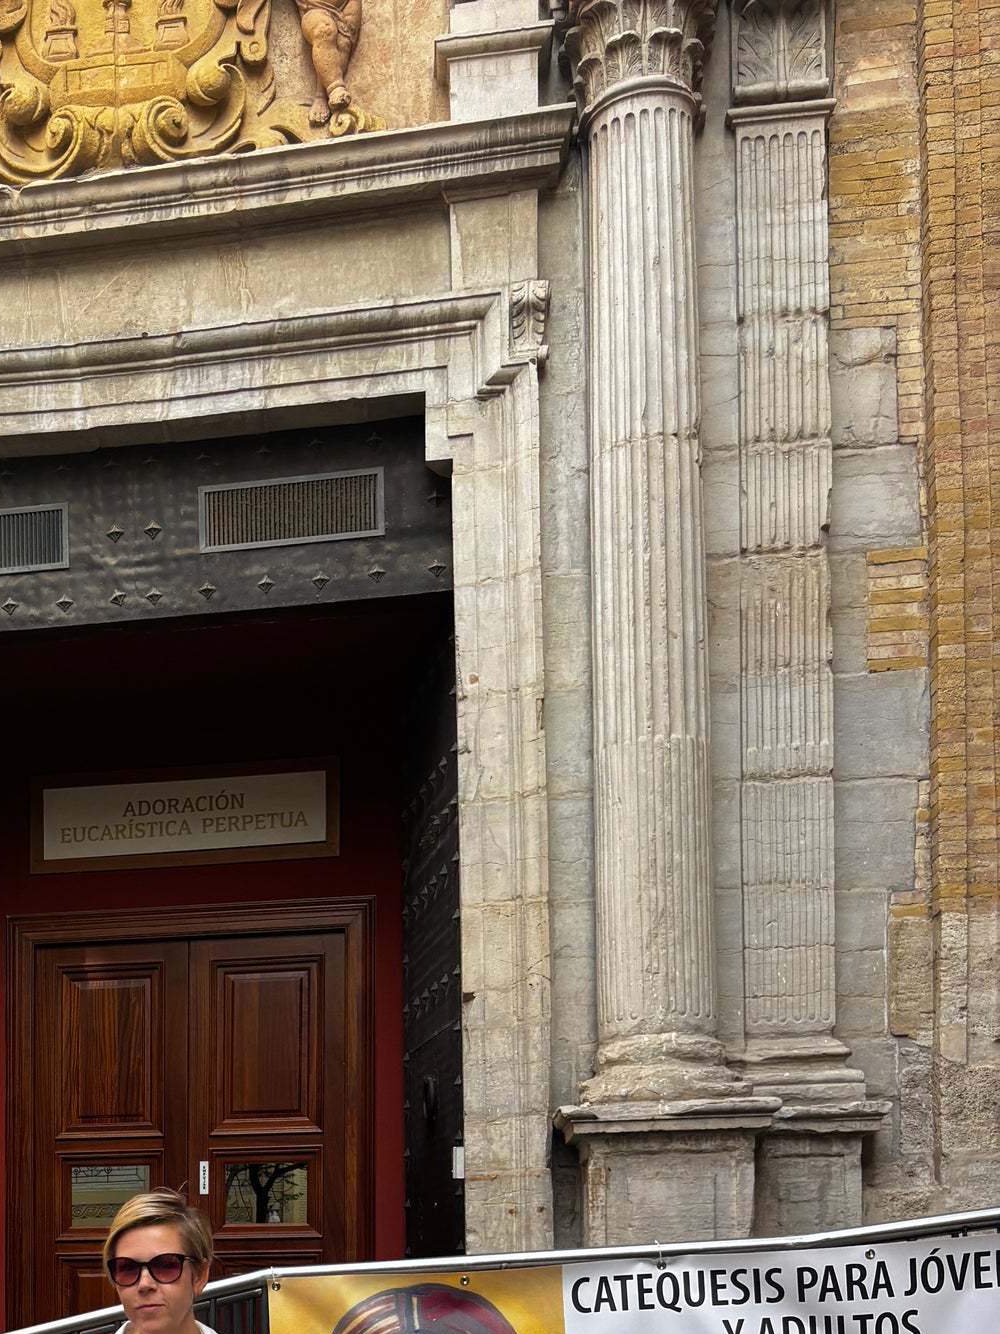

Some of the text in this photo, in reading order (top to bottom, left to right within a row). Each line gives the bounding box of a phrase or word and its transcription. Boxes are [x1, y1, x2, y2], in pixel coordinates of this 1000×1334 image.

[122, 790, 245, 818] ADORACIÓN
[60, 811, 308, 844] EUCARÍSTICA PERPETUA
[571, 1267, 785, 1313] CATEQUESIS
[799, 1261, 894, 1303] PARA
